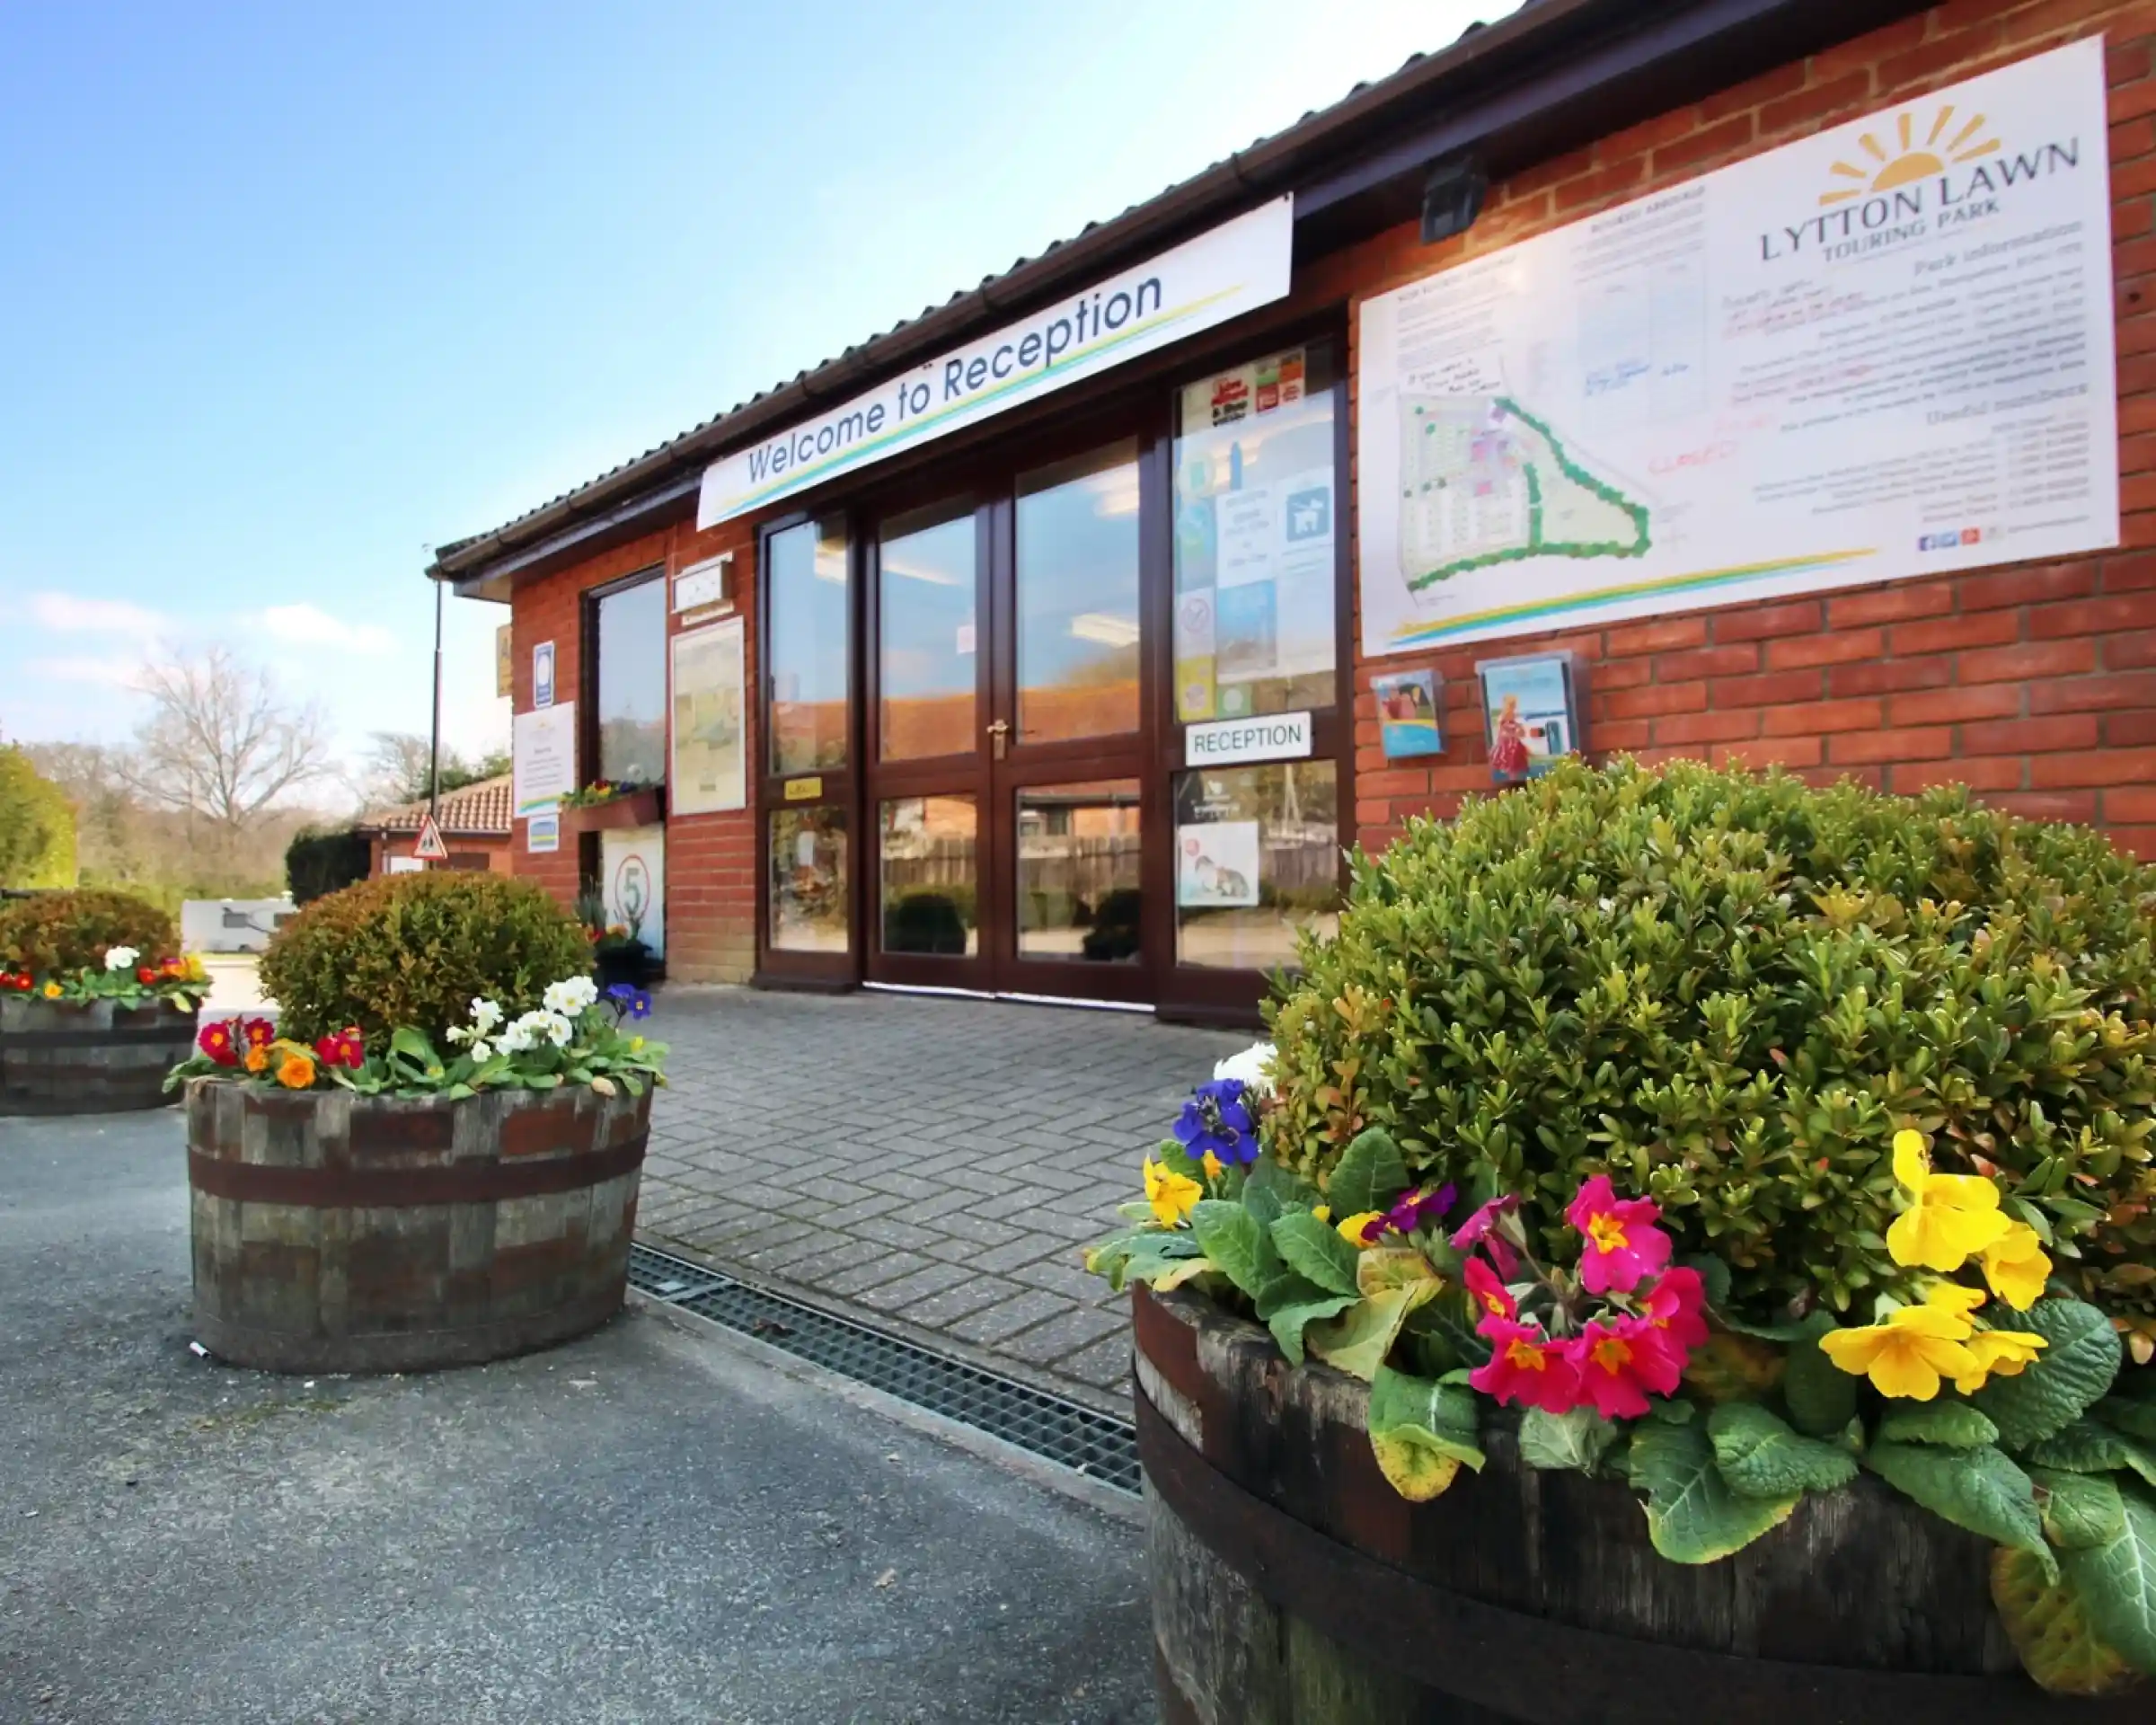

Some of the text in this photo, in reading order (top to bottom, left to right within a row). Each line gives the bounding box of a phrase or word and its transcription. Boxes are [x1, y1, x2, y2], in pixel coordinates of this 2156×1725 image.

[1760, 186, 1922, 262] LYTTON
[1940, 137, 2079, 207] LAWN
[1823, 197, 2001, 262] TOURING PARK
[1914, 252, 1957, 277] Park
[747, 402, 886, 484] Welcome
[897, 368, 931, 415] to
[945, 274, 1162, 403] Reception
[1193, 722, 1303, 754] RECEPTION
[623, 866, 641, 914] 5
